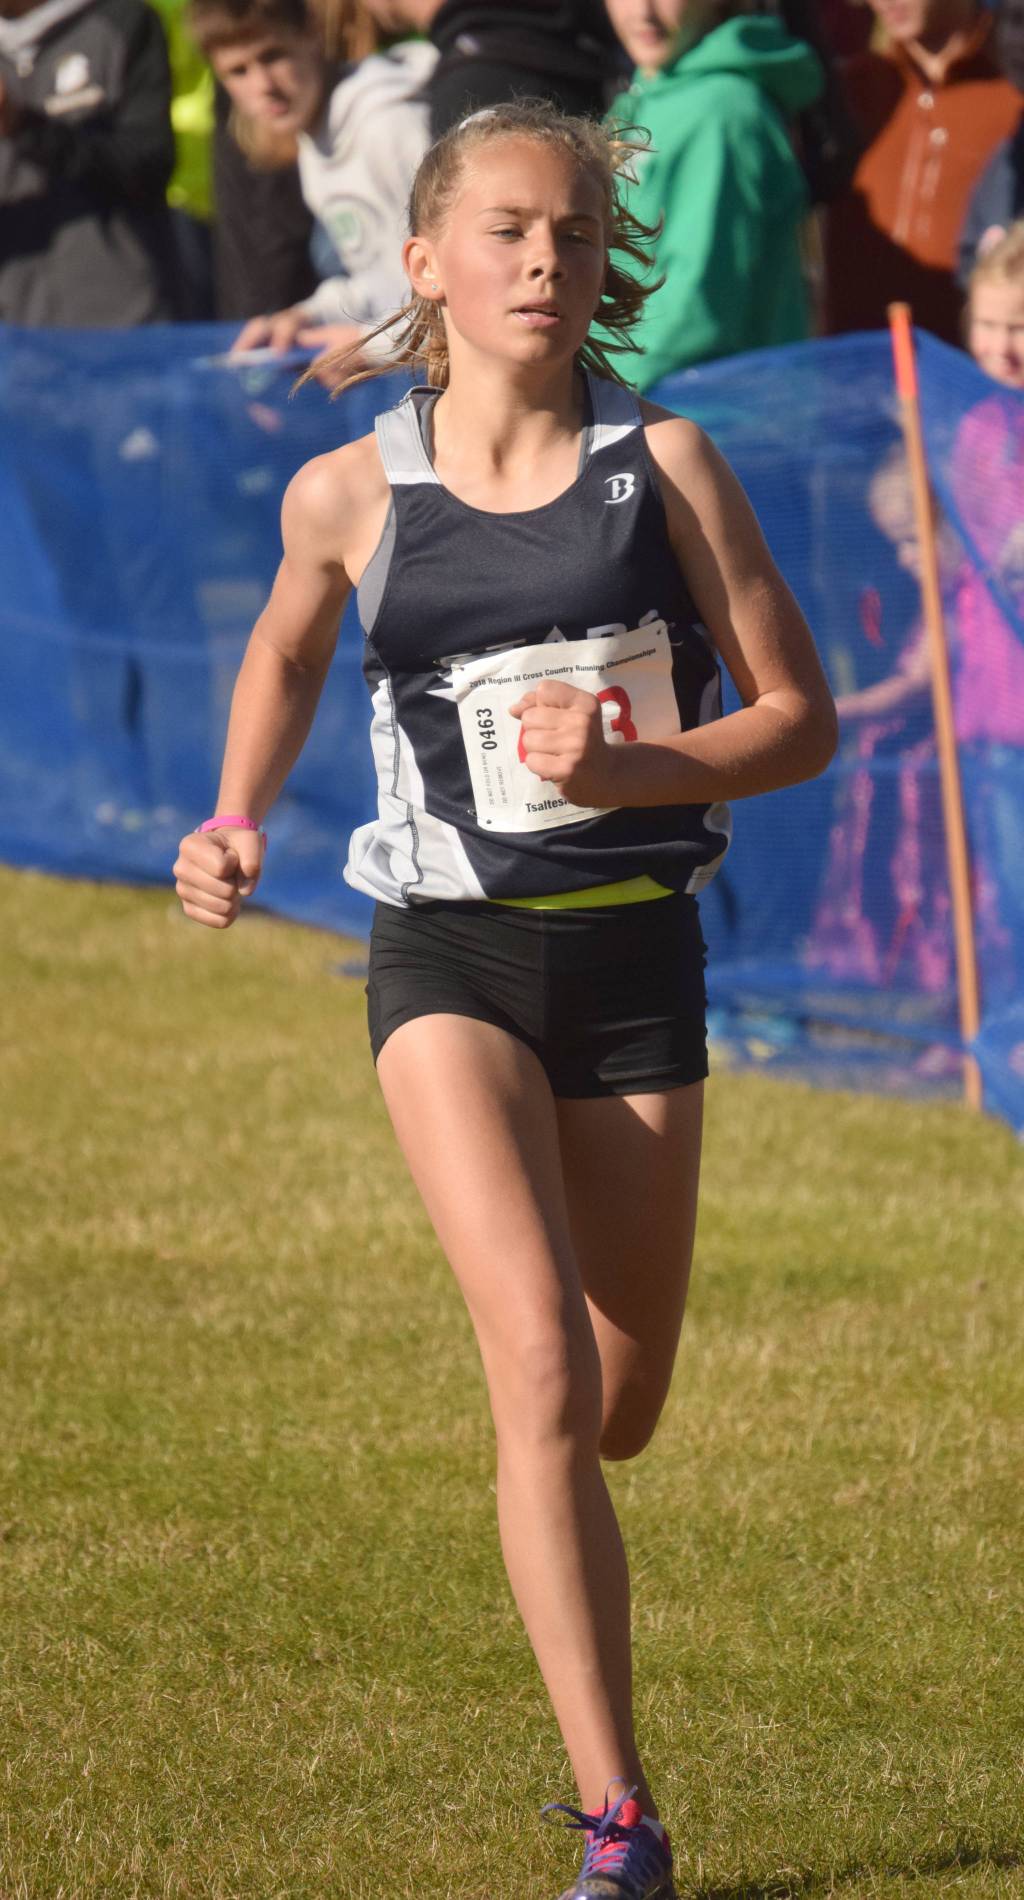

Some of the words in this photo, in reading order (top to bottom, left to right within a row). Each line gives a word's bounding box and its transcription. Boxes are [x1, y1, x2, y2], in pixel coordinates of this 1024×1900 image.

[469, 680, 486, 688] 2018
[488, 676, 512, 685] Region
[522, 672, 543, 681] Cross
[545, 666, 574, 676] Country
[606, 648, 656, 668] Championships
[476, 708, 498, 750] 0463
[525, 798, 568, 812] Tsaltes
